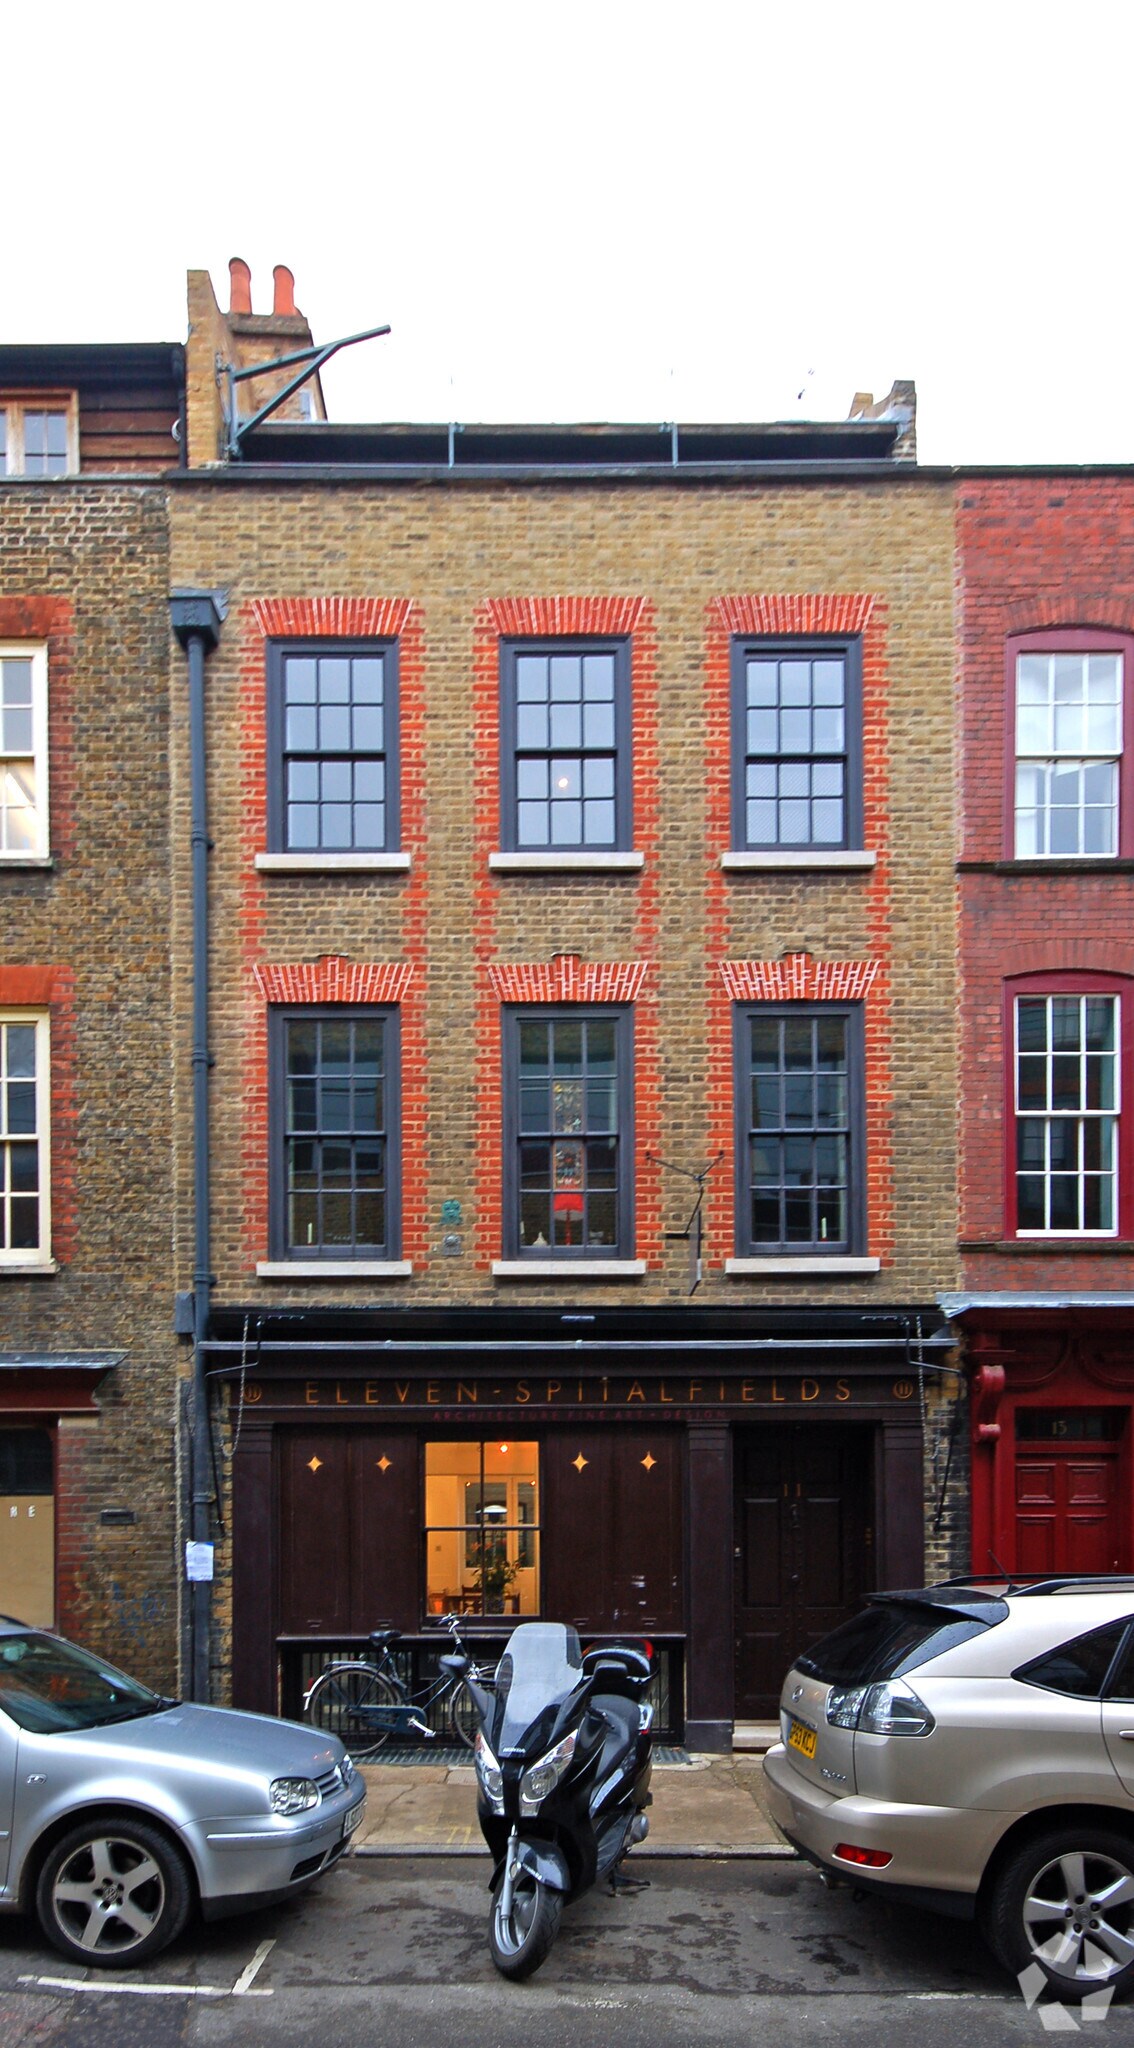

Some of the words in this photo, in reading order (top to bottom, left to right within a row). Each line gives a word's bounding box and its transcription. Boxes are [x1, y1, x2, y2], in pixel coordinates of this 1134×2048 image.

[433, 1411, 559, 1421] ARCHITECTURE
[567, 1410, 607, 1420] FINE
[615, 1410, 643, 1420] ART
[663, 1410, 726, 1420] DESIGN
